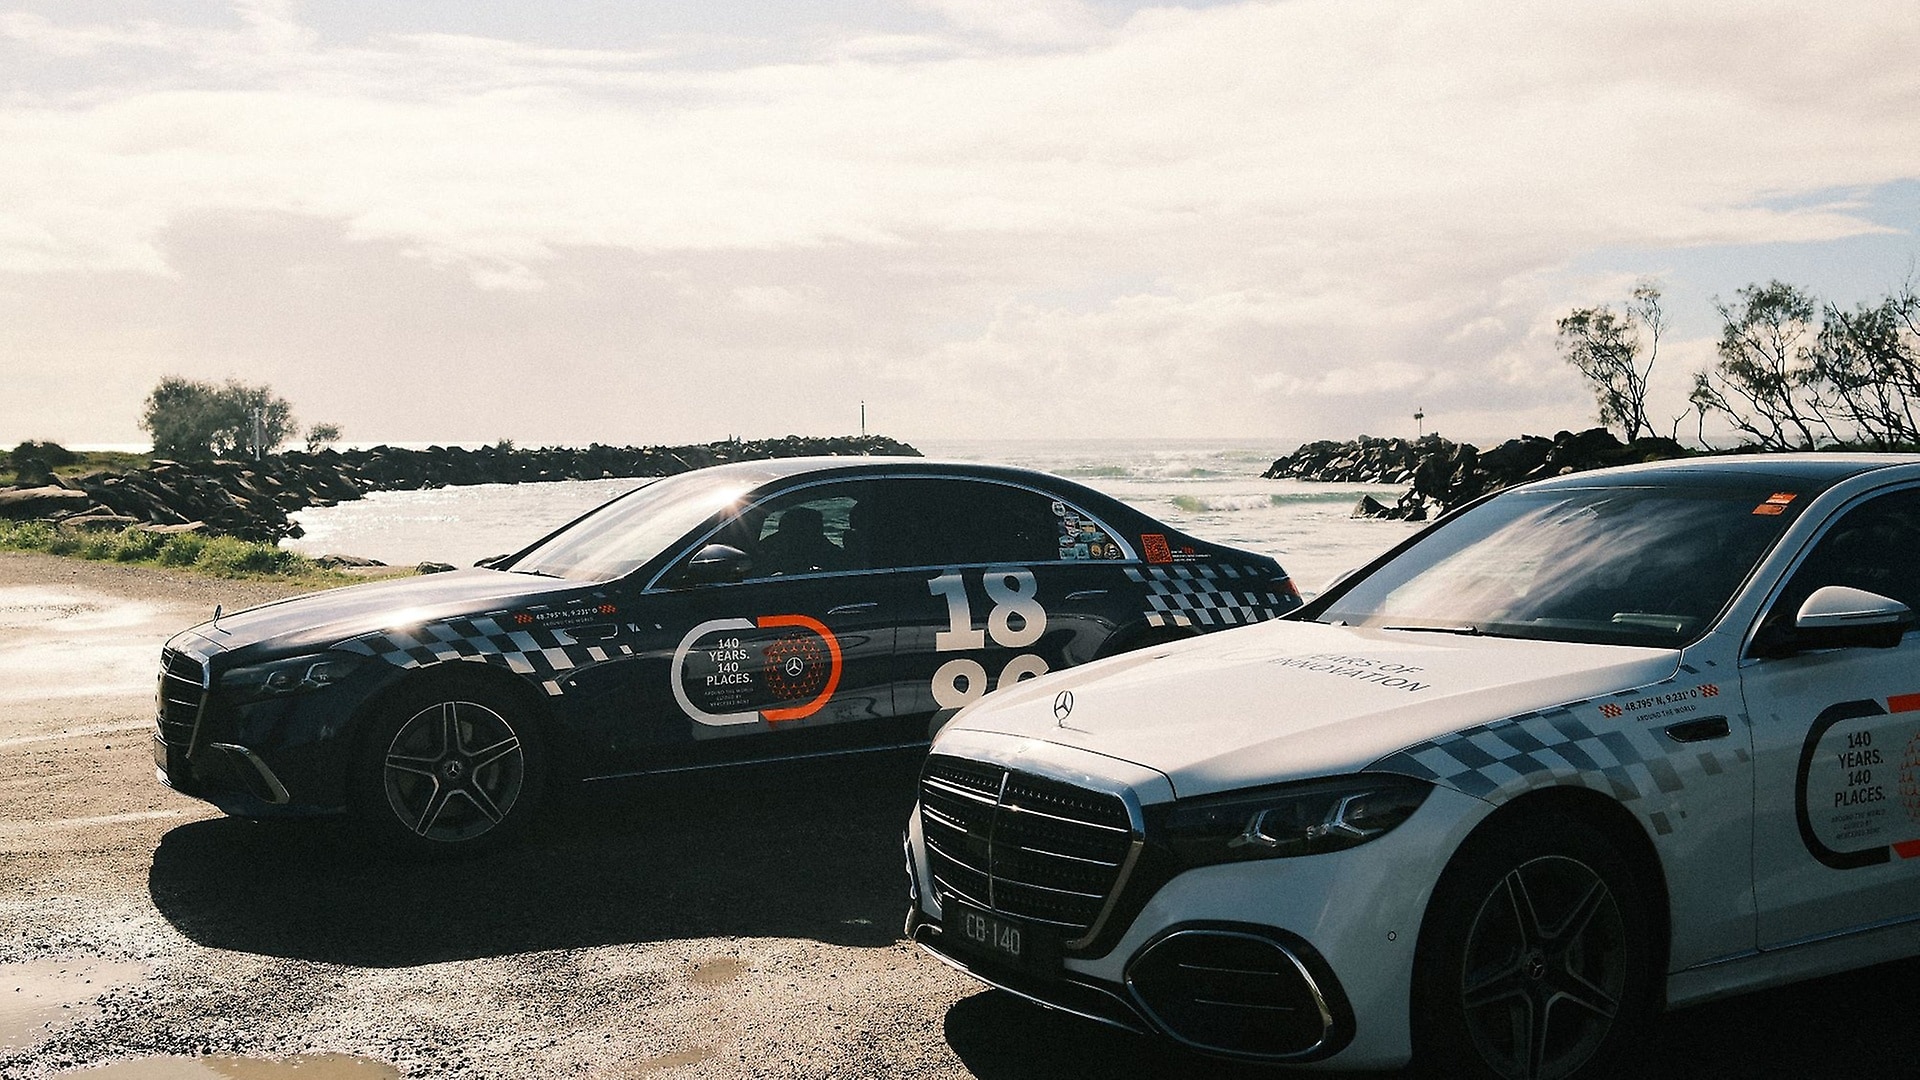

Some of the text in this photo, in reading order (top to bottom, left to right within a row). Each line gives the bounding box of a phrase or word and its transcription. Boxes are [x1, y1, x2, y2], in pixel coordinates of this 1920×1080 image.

[928, 567, 1047, 652] 18
[718, 638, 739, 649] 140
[709, 649, 750, 662] YEARS.
[718, 662, 739, 674] 140
[706, 673, 753, 686] PLACES.
[1625, 696, 1654, 712] 48.795°
[1666, 691, 1689, 703] 9.231°
[1848, 731, 1871, 749] 140
[1838, 749, 1884, 769] YEARS.
[1848, 769, 1871, 787] 140
[1834, 785, 1886, 808] PLACES.
